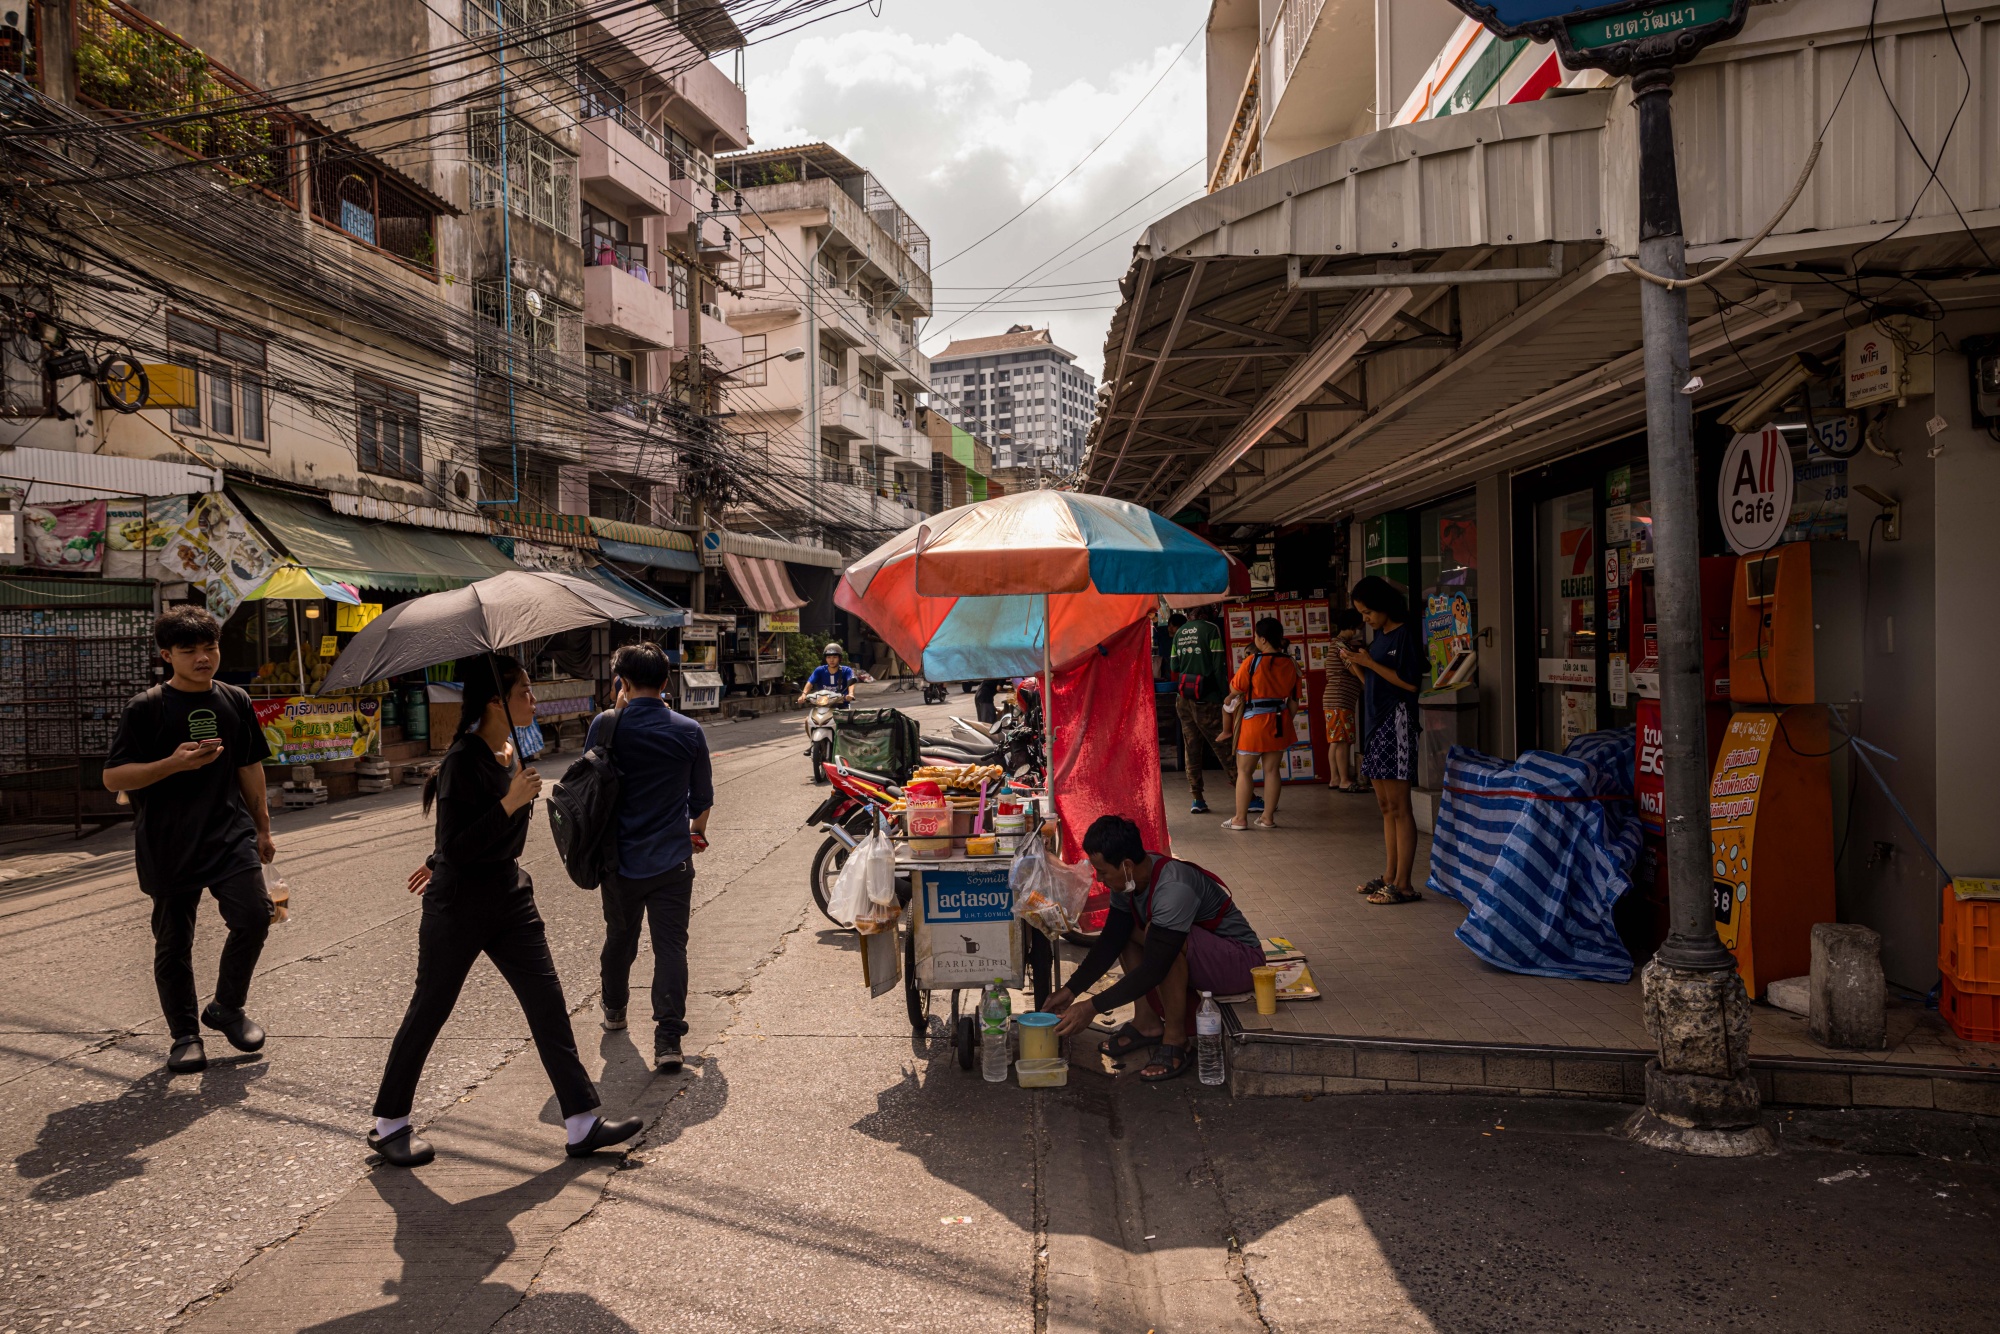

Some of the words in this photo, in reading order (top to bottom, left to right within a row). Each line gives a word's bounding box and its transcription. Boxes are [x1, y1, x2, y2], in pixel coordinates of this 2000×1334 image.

[1605, 5, 1696, 39] เขตวัฒนา
[1860, 350, 1878, 364] WiFi
[1808, 420, 1848, 454] 255
[1732, 430, 1777, 496] All
[1732, 494, 1774, 524] Café
[1560, 527, 1592, 575] 7
[1181, 626, 1198, 635] Grab
[848, 744, 881, 756] Grab
[1640, 791, 1663, 814] No.1
[966, 873, 1009, 886] Soymilk
[926, 882, 1010, 919] Lactasoy
[937, 959, 974, 967] EARLY
[978, 959, 1007, 967] BIRD
